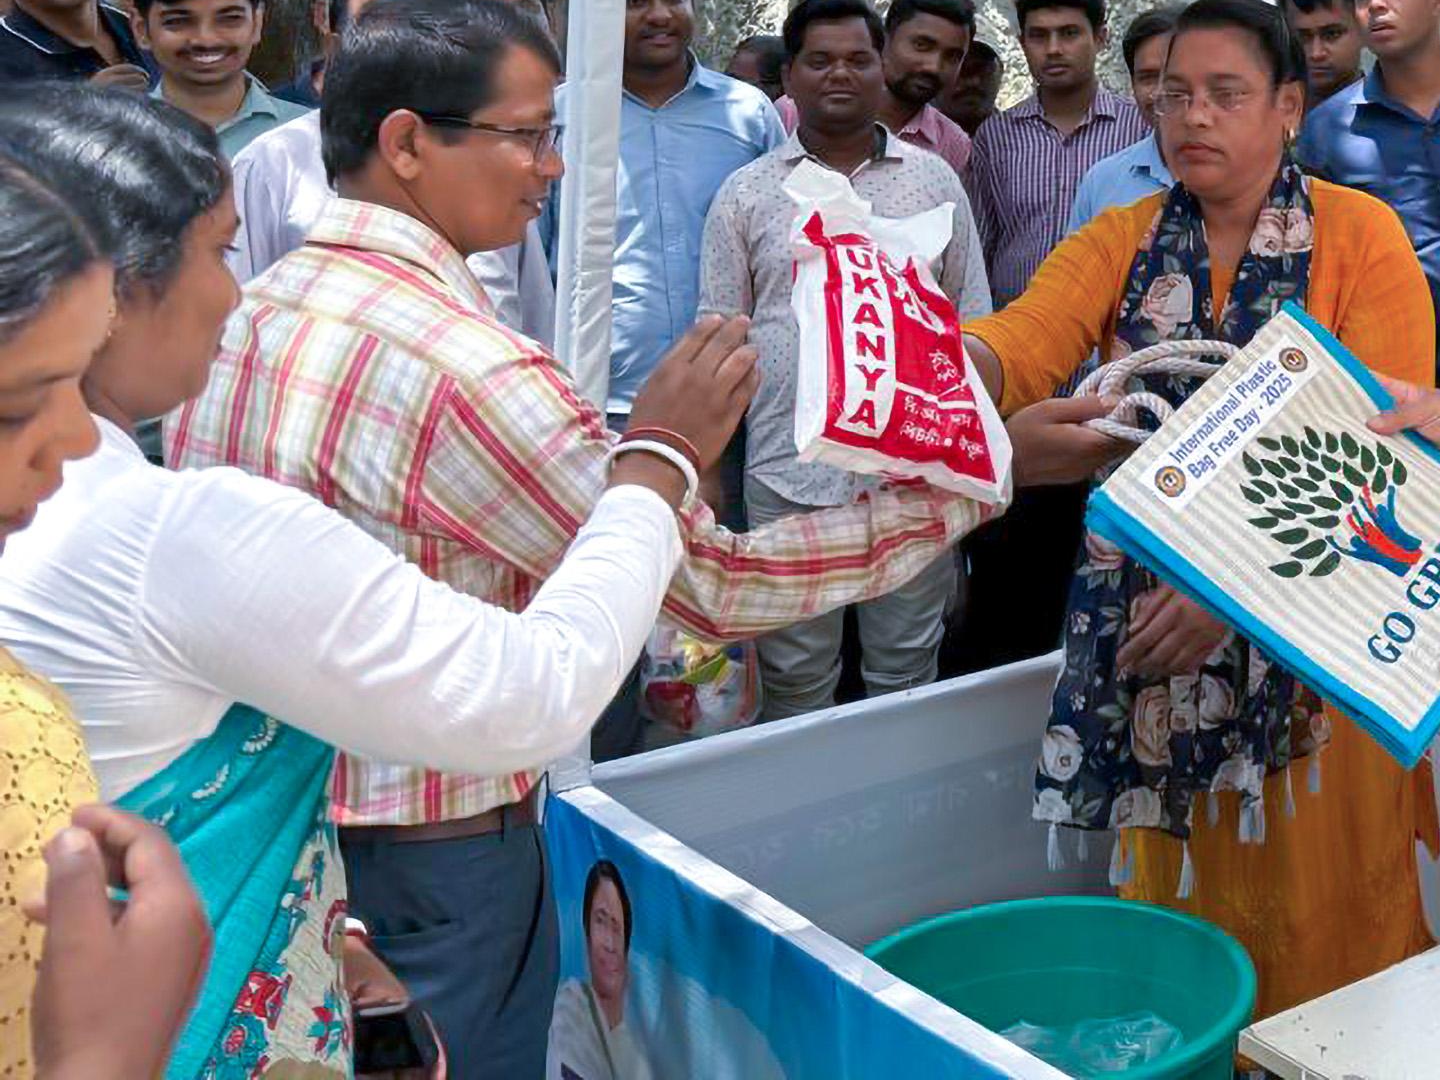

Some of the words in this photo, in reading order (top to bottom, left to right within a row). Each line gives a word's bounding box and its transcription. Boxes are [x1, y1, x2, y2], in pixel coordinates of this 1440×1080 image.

[846, 248, 887, 430] UKANYA
[1168, 393, 1241, 464] International
[1235, 360, 1278, 399] Plastic
[1187, 454, 1217, 480] Bag
[1208, 429, 1240, 458] Free
[1233, 407, 1261, 433] Day
[1260, 373, 1293, 407] 2025
[1367, 611, 1416, 663] GO
